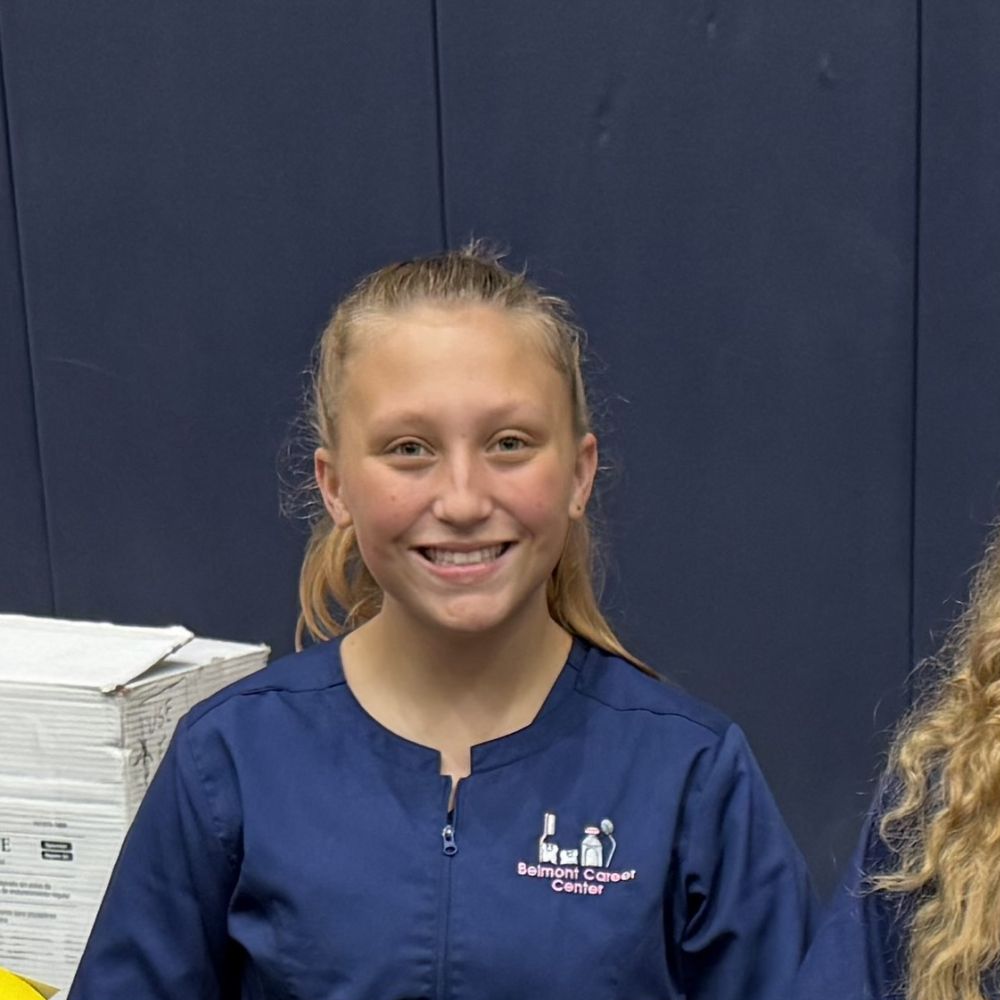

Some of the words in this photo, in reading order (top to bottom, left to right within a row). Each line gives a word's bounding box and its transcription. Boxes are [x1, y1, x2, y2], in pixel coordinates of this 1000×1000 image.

[517, 862, 580, 880] Belmont
[583, 868, 637, 883] Career
[551, 879, 605, 895] Center
